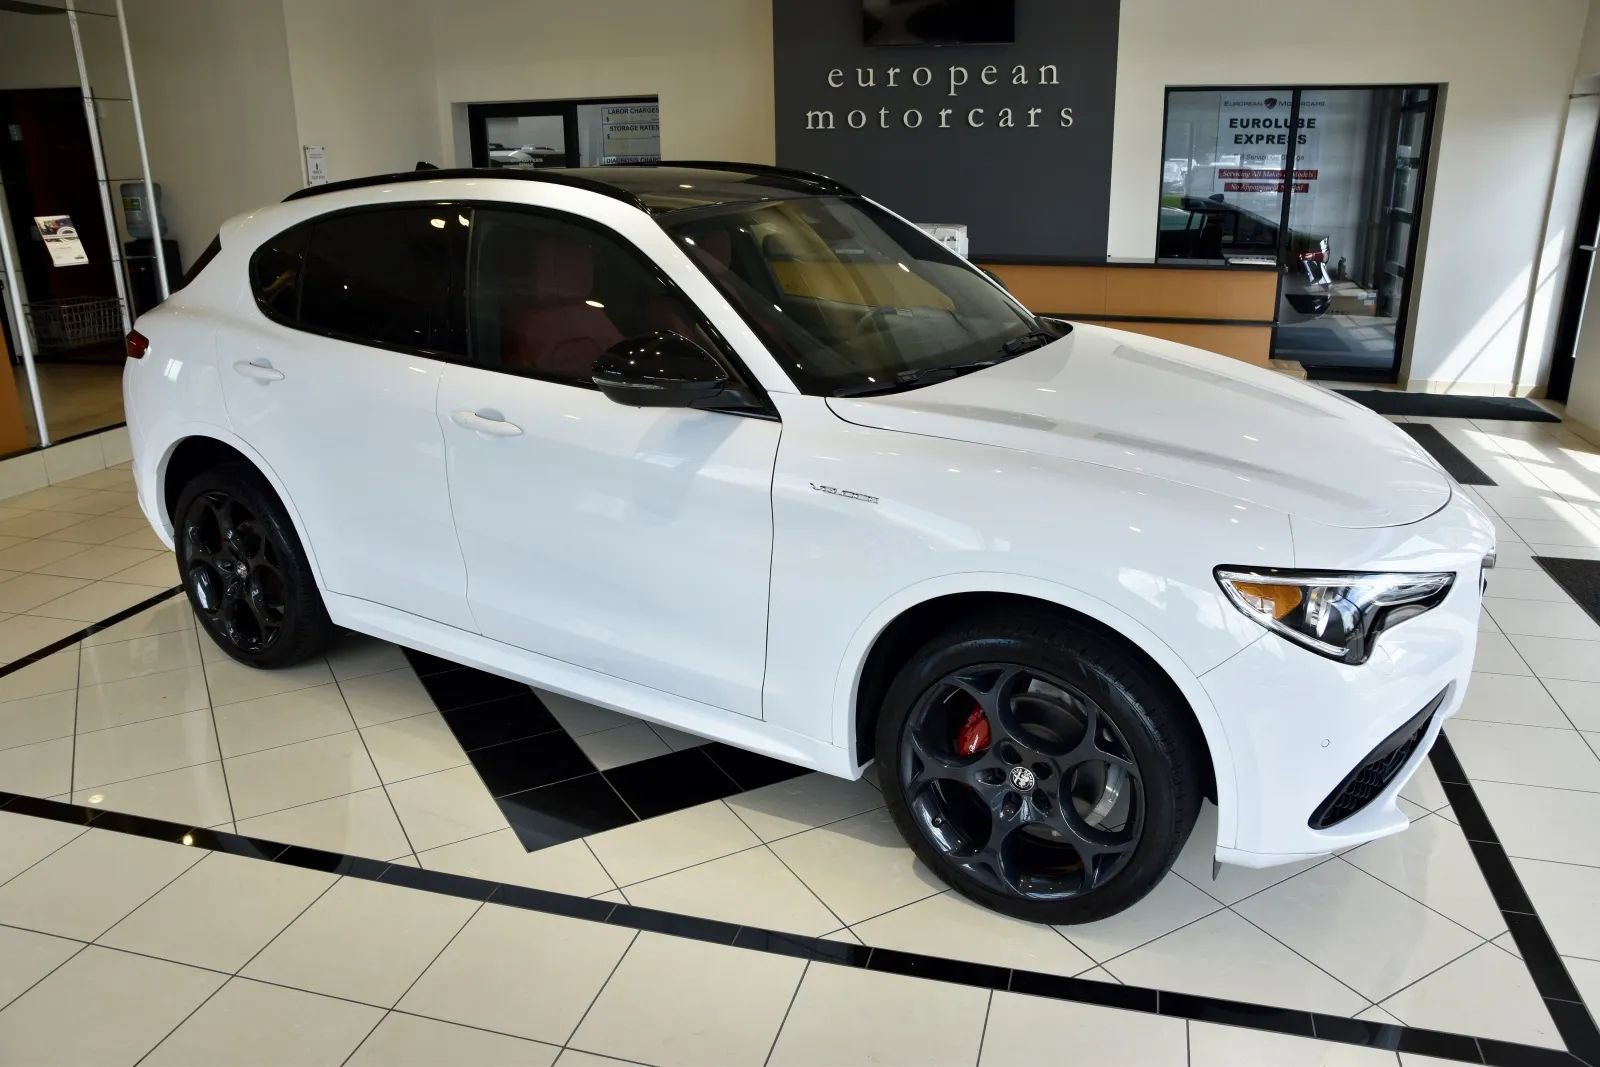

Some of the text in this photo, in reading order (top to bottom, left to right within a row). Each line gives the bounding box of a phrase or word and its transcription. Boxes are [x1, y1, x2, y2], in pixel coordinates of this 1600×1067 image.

[827, 64, 1060, 96] european
[805, 106, 1073, 129] motorcars
[1234, 134, 1307, 144] EXPRES
